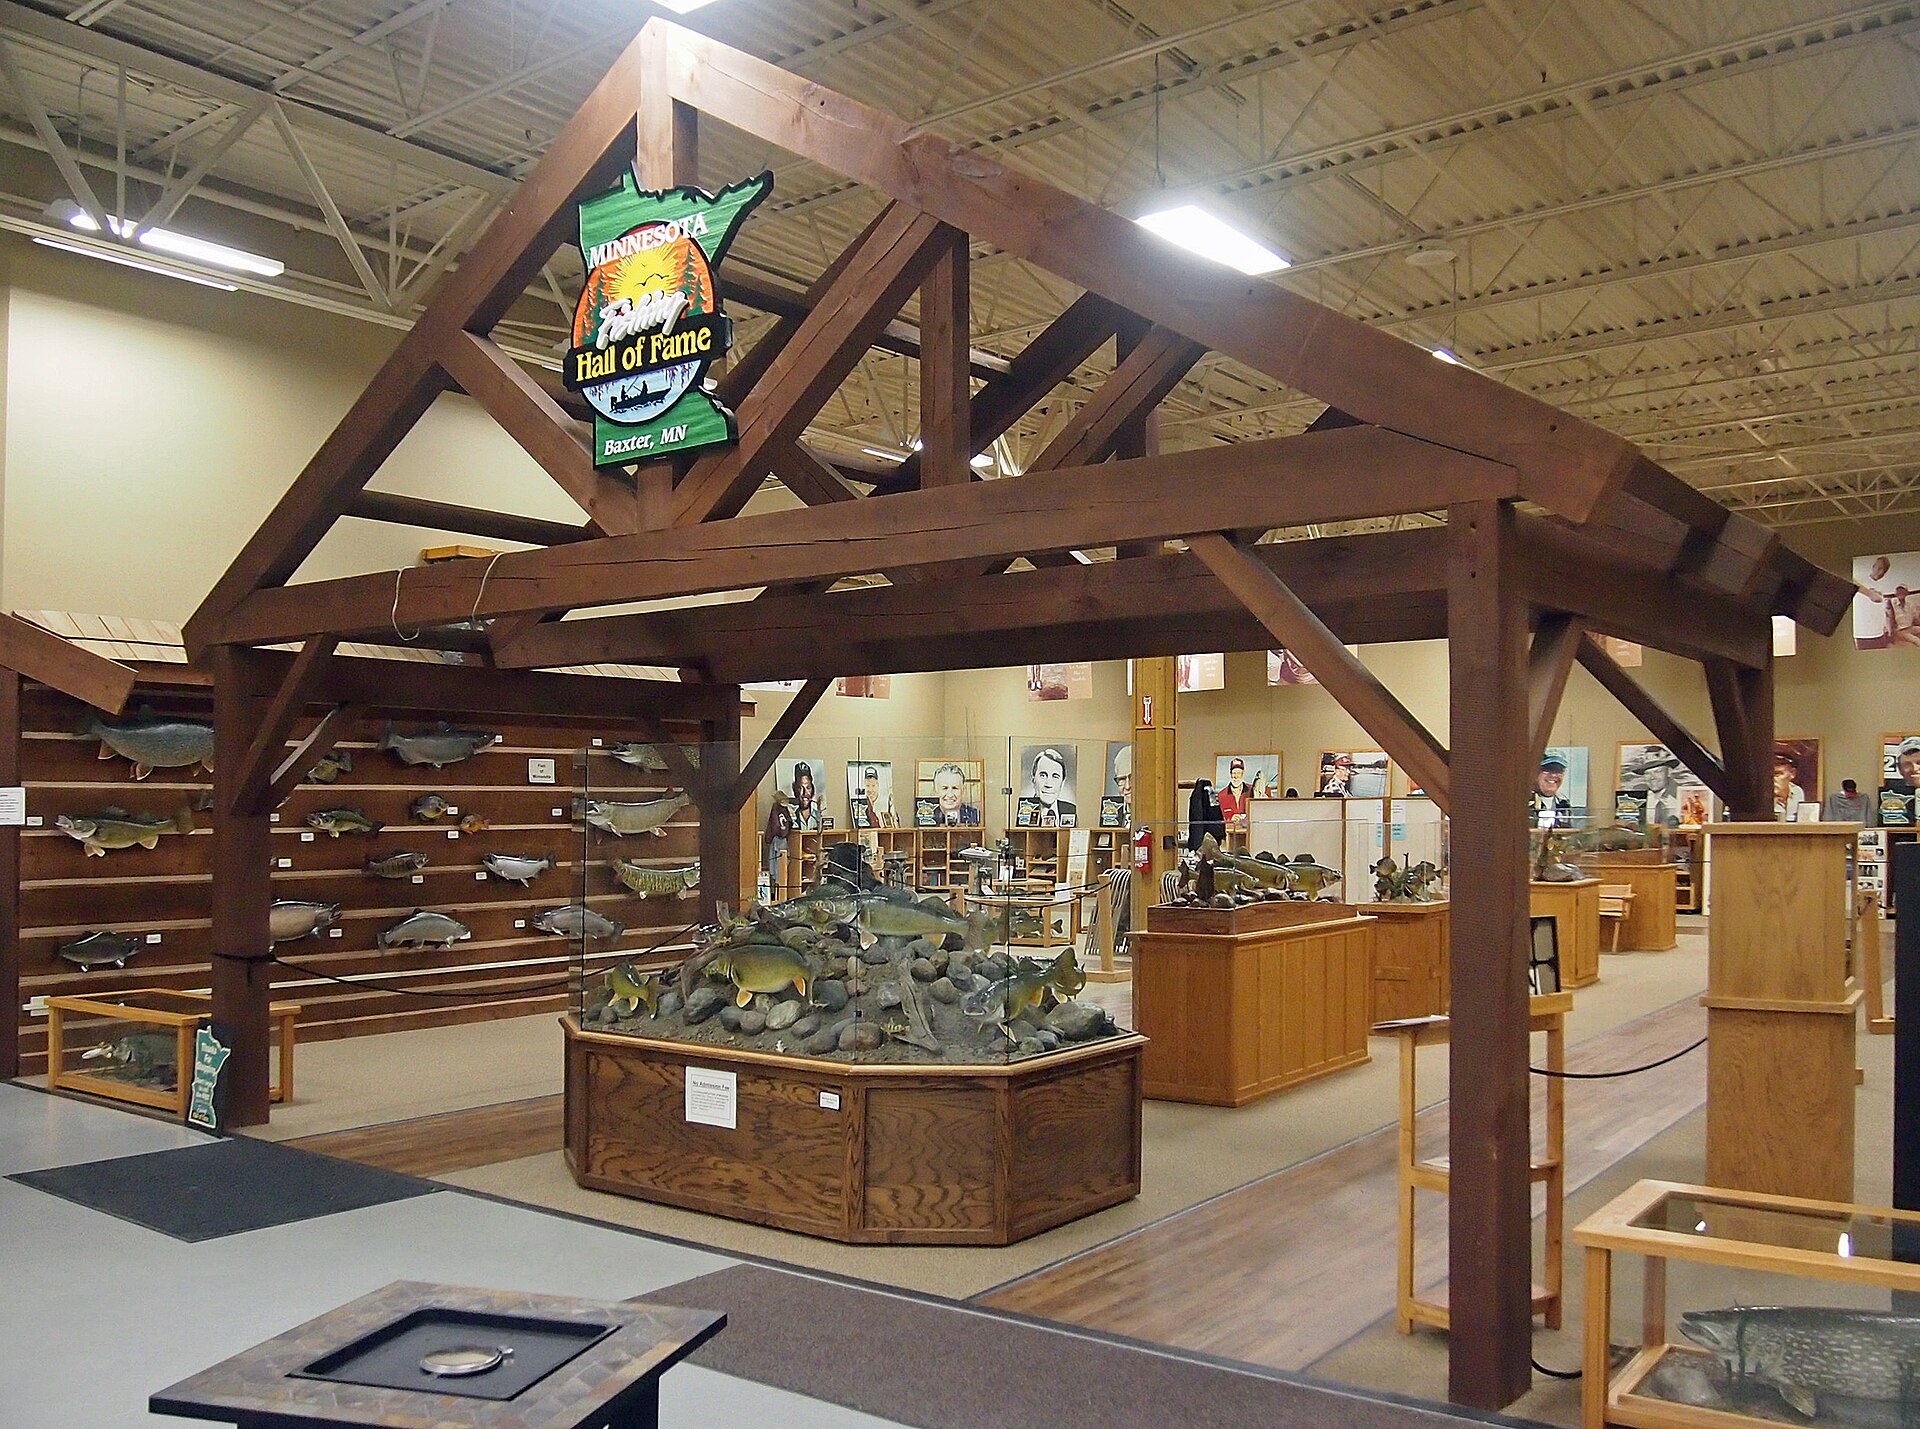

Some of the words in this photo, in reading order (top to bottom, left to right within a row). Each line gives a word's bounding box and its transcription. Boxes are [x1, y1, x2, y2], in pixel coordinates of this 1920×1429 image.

[588, 212, 709, 269] MINNESOTA
[595, 289, 689, 350] Fishing
[576, 344, 616, 382] Hall
[621, 334, 647, 371] of
[649, 326, 712, 364] Fame
[603, 433, 655, 457] Baxter,
[659, 424, 689, 446] MN
